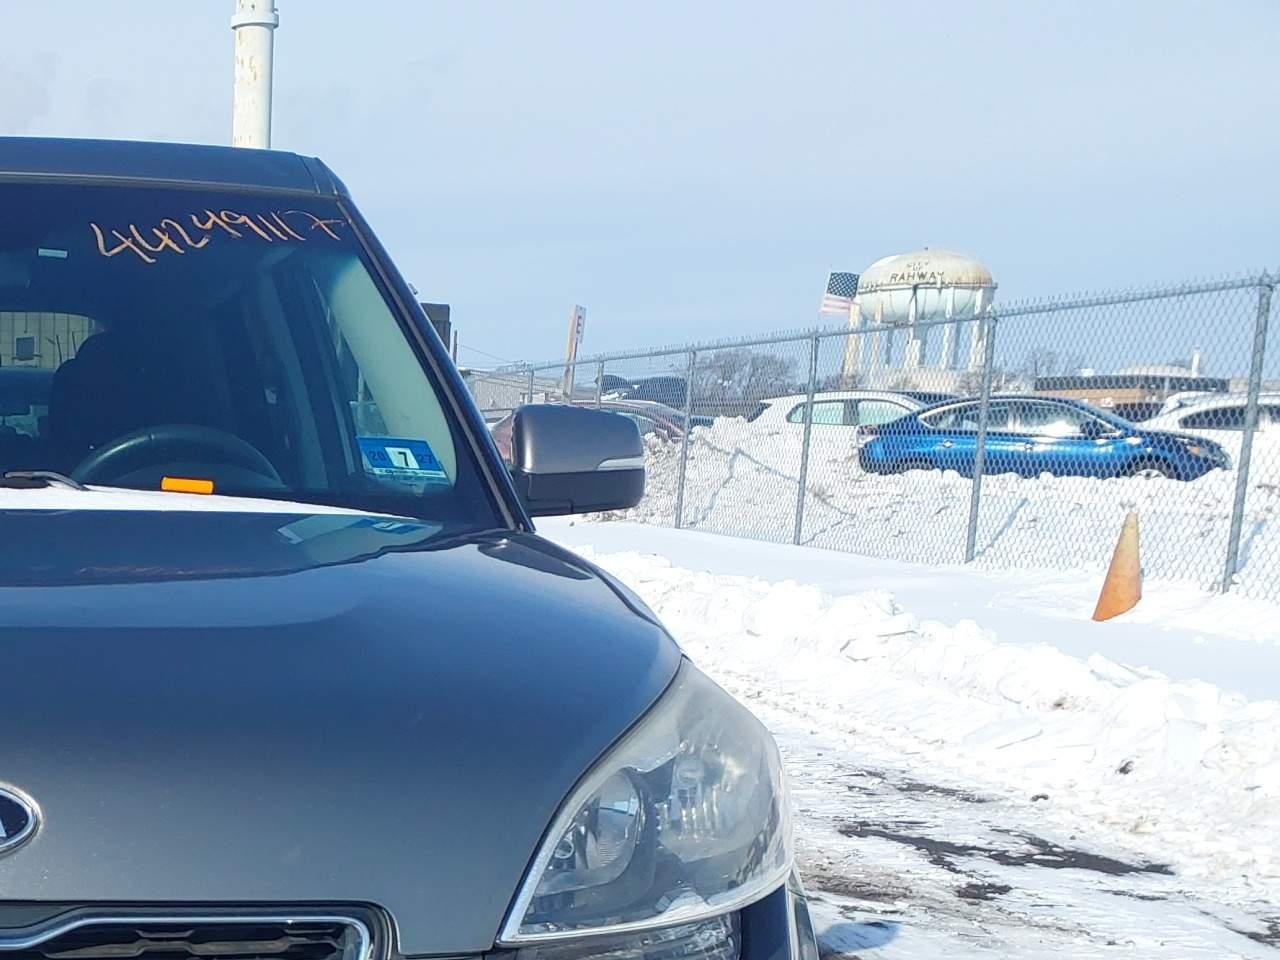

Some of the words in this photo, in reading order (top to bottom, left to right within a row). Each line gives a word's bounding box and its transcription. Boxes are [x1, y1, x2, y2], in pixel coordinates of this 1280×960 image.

[89, 208, 346, 263] 44249117
[889, 271, 945, 282] RAHWAY
[398, 451, 410, 467] 7
